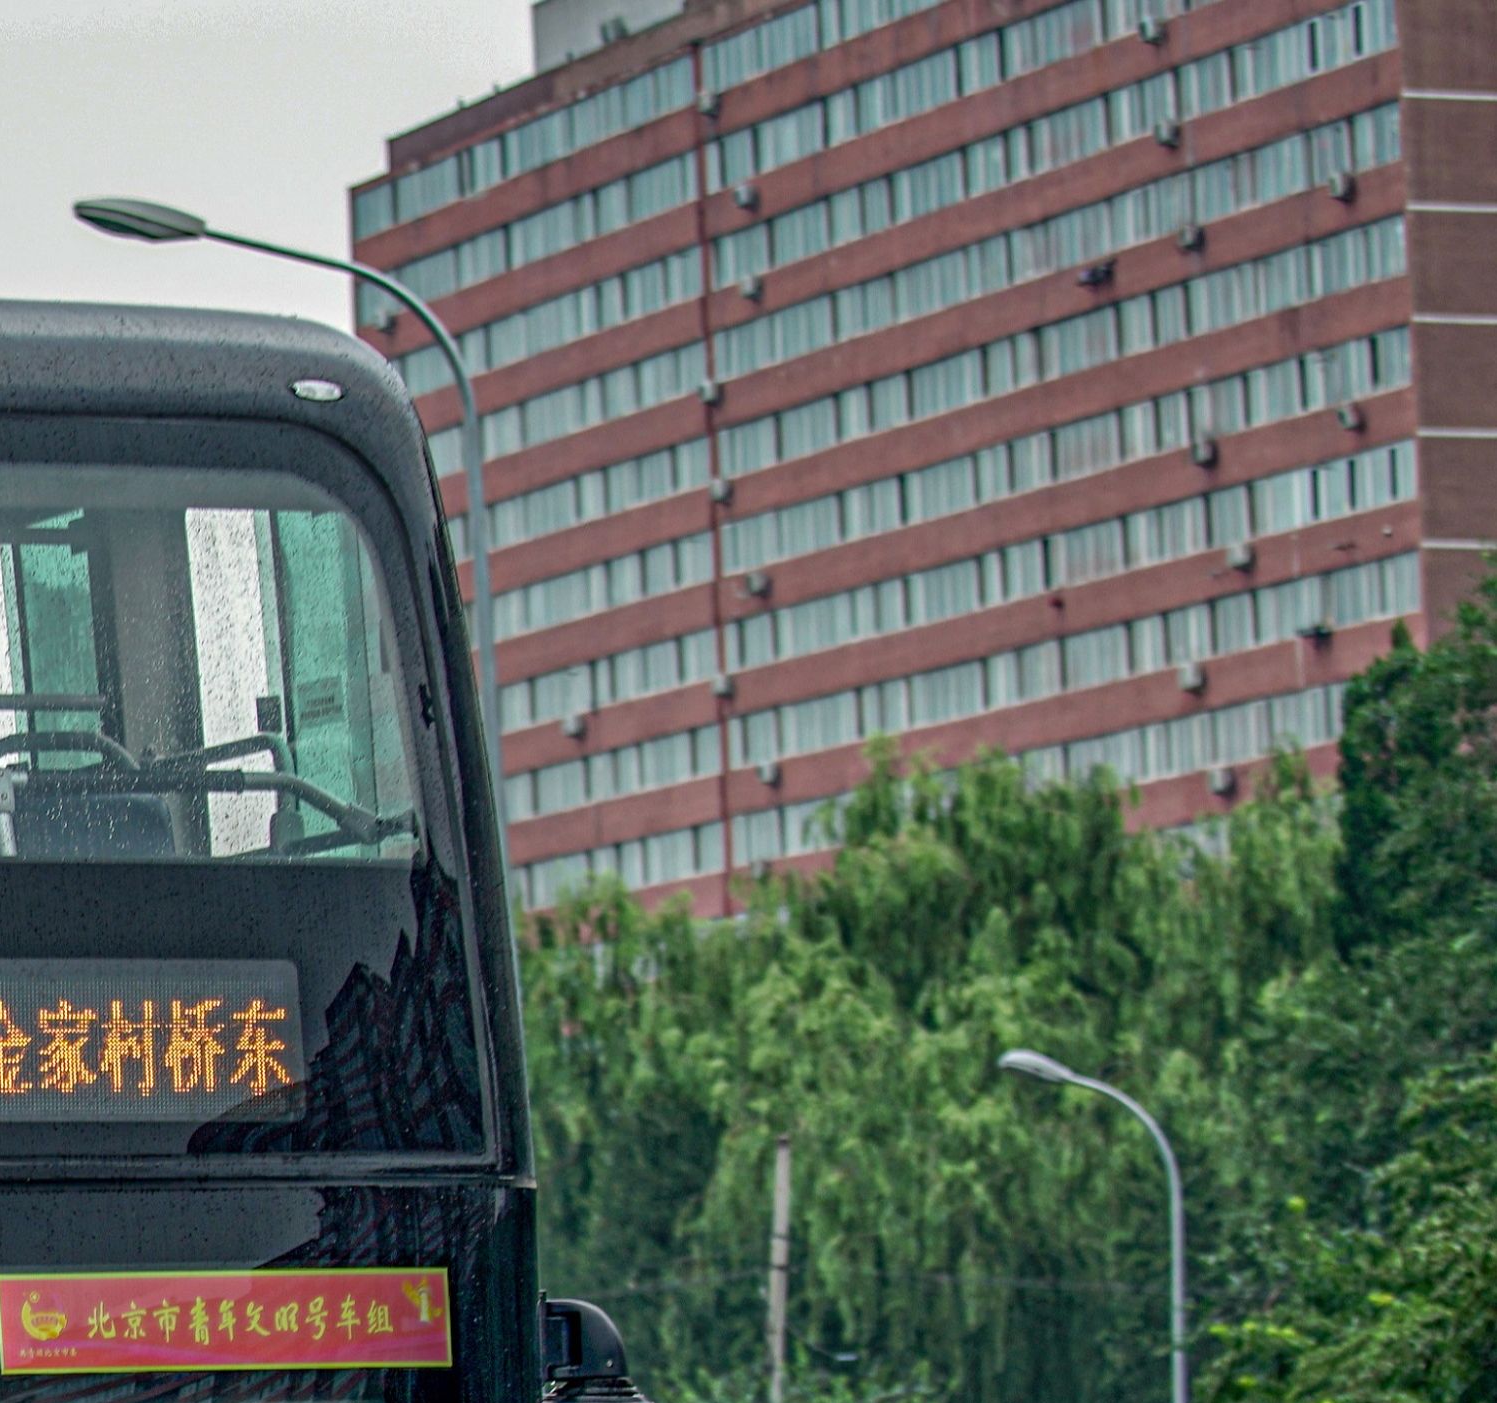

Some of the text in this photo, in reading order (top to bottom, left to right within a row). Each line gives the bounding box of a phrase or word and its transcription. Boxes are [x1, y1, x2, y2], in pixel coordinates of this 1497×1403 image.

[87, 1294, 395, 1346] 北京市青年文明号车组
